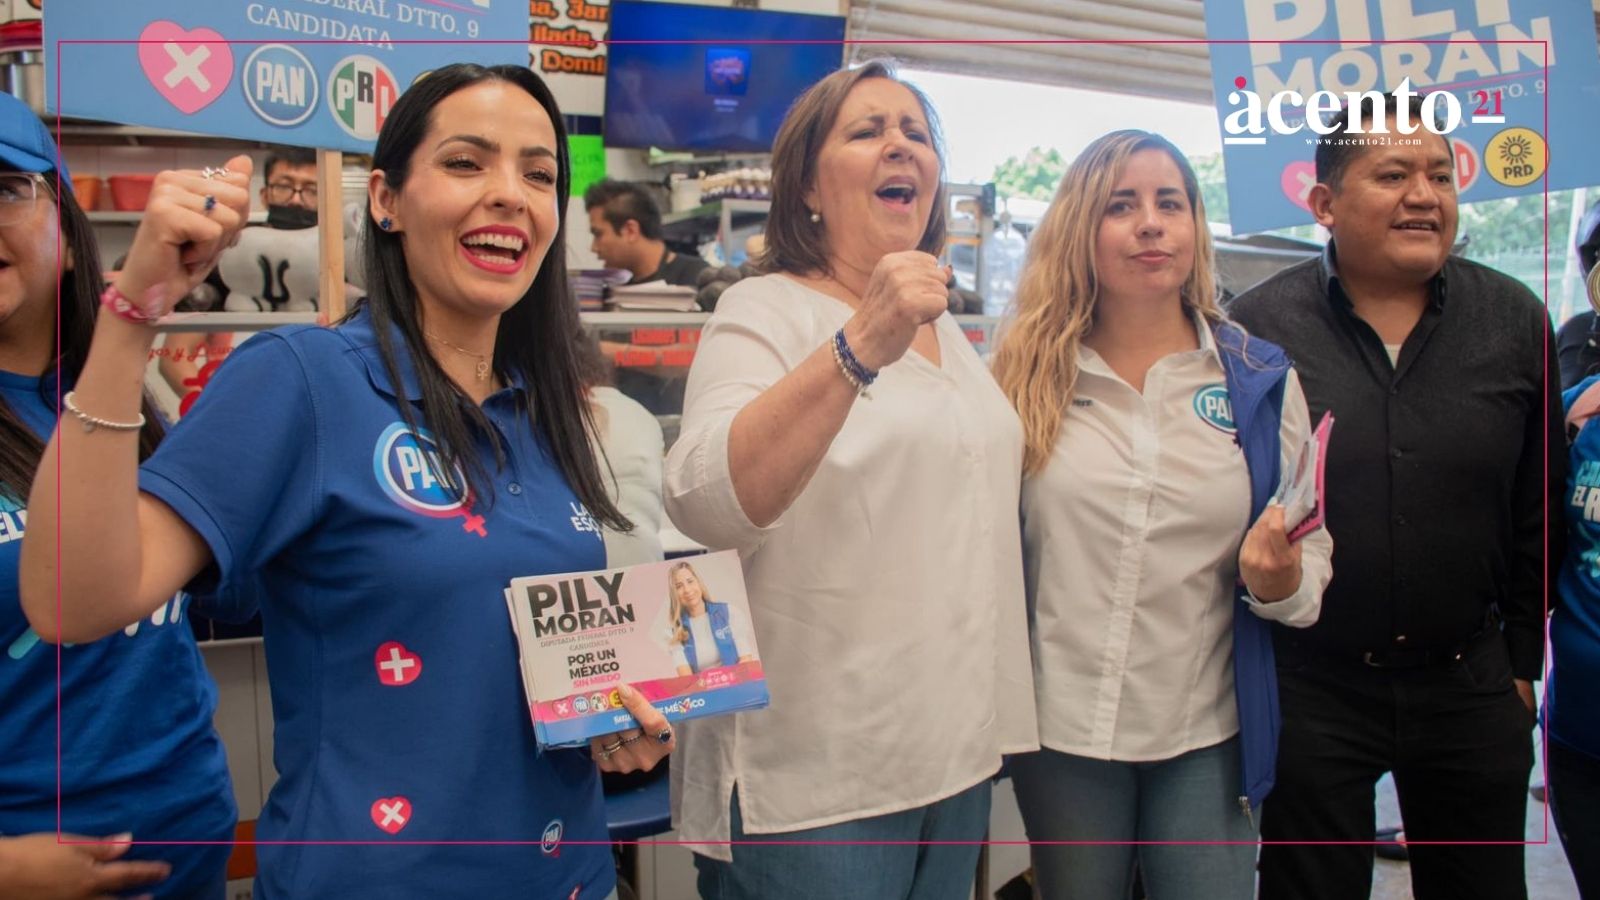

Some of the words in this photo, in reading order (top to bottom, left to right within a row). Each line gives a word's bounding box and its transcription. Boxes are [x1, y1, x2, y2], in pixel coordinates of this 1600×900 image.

[247, 4, 394, 50] CANDIDATA
[396, 5, 460, 34] DTTO.
[467, 20, 479, 38] 9
[1252, 16, 1556, 114] MORAN
[256, 61, 305, 107] PAN
[336, 71, 389, 118] PRI
[1503, 164, 1534, 179] PRD
[1205, 395, 1233, 421] PA
[527, 572, 624, 618] PILY
[533, 603, 635, 638] MORAN
[568, 652, 595, 666] POR
[596, 648, 616, 661] UN
[569, 661, 620, 680] MÉXICO
[573, 678, 590, 688] SIN
[590, 672, 621, 685] MIEDO
